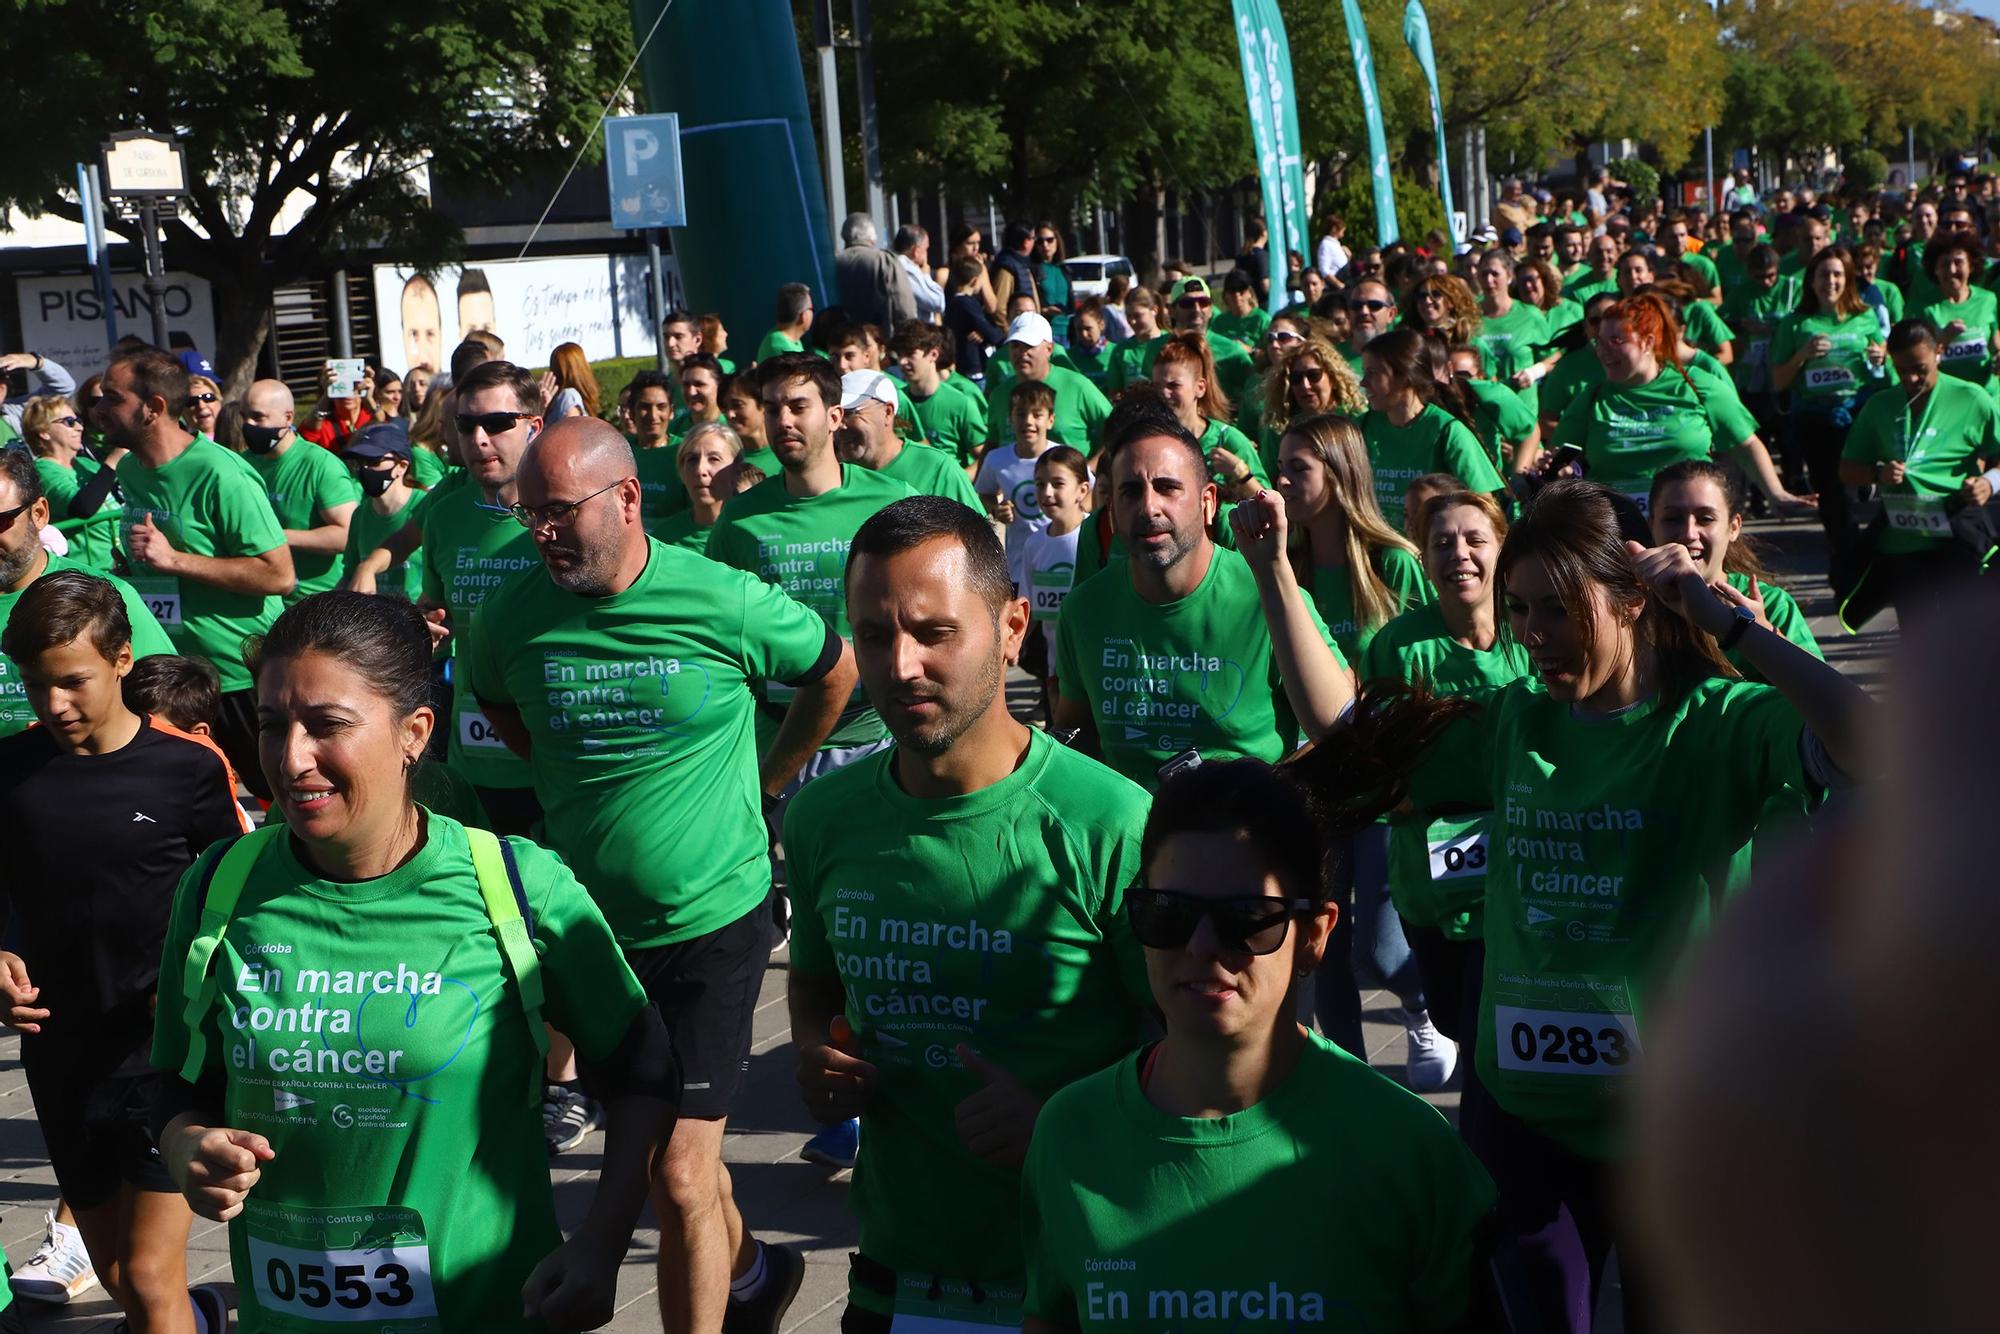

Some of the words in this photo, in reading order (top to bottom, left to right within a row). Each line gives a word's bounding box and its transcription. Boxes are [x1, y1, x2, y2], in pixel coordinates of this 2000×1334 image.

[623, 128, 660, 177] P
[758, 542, 779, 559] En
[785, 537, 852, 555] marcha
[456, 554, 474, 570] En
[479, 556, 538, 571] march
[760, 557, 815, 576] contra
[453, 573, 501, 587] contra
[451, 589, 463, 604] el
[1037, 591, 1069, 609] 025
[150, 600, 176, 620] 27
[544, 661, 576, 682] En
[586, 655, 681, 681] marcha
[1102, 648, 1129, 669] En
[1135, 651, 1221, 673] marcha
[547, 685, 626, 706] contra
[1102, 675, 1170, 695] contra
[550, 710, 570, 731] el
[577, 707, 664, 729] cáncer
[1102, 695, 1118, 716] el
[1124, 696, 1201, 719] cáncer
[1505, 796, 1527, 827] En
[1535, 803, 1643, 832] marcha
[1445, 845, 1487, 872] 03
[1506, 835, 1585, 862] contra
[1531, 866, 1624, 897] cáncer
[836, 888, 875, 902] Córdoba
[834, 906, 867, 940] En
[879, 919, 1013, 954] marcha
[244, 942, 292, 955] Córdoba
[236, 962, 282, 993] En
[296, 963, 442, 995] marcha
[836, 950, 932, 985] contra
[232, 1001, 351, 1033] contra
[864, 988, 987, 1022] cáncer
[906, 1022, 936, 1031] CONTRA
[232, 1036, 256, 1070] el
[268, 1040, 404, 1074] cáncer
[1511, 1022, 1630, 1066] 0283
[272, 1079, 311, 1089] ESPAÑOLA
[313, 1081, 345, 1089] CONTRA
[326, 1214, 363, 1225] Contra
[365, 1212, 375, 1223] el
[1084, 1257, 1137, 1272] Córdoba
[266, 1257, 414, 1310] 0553
[1086, 1280, 1129, 1321] En
[1148, 1280, 1325, 1322] marcha
